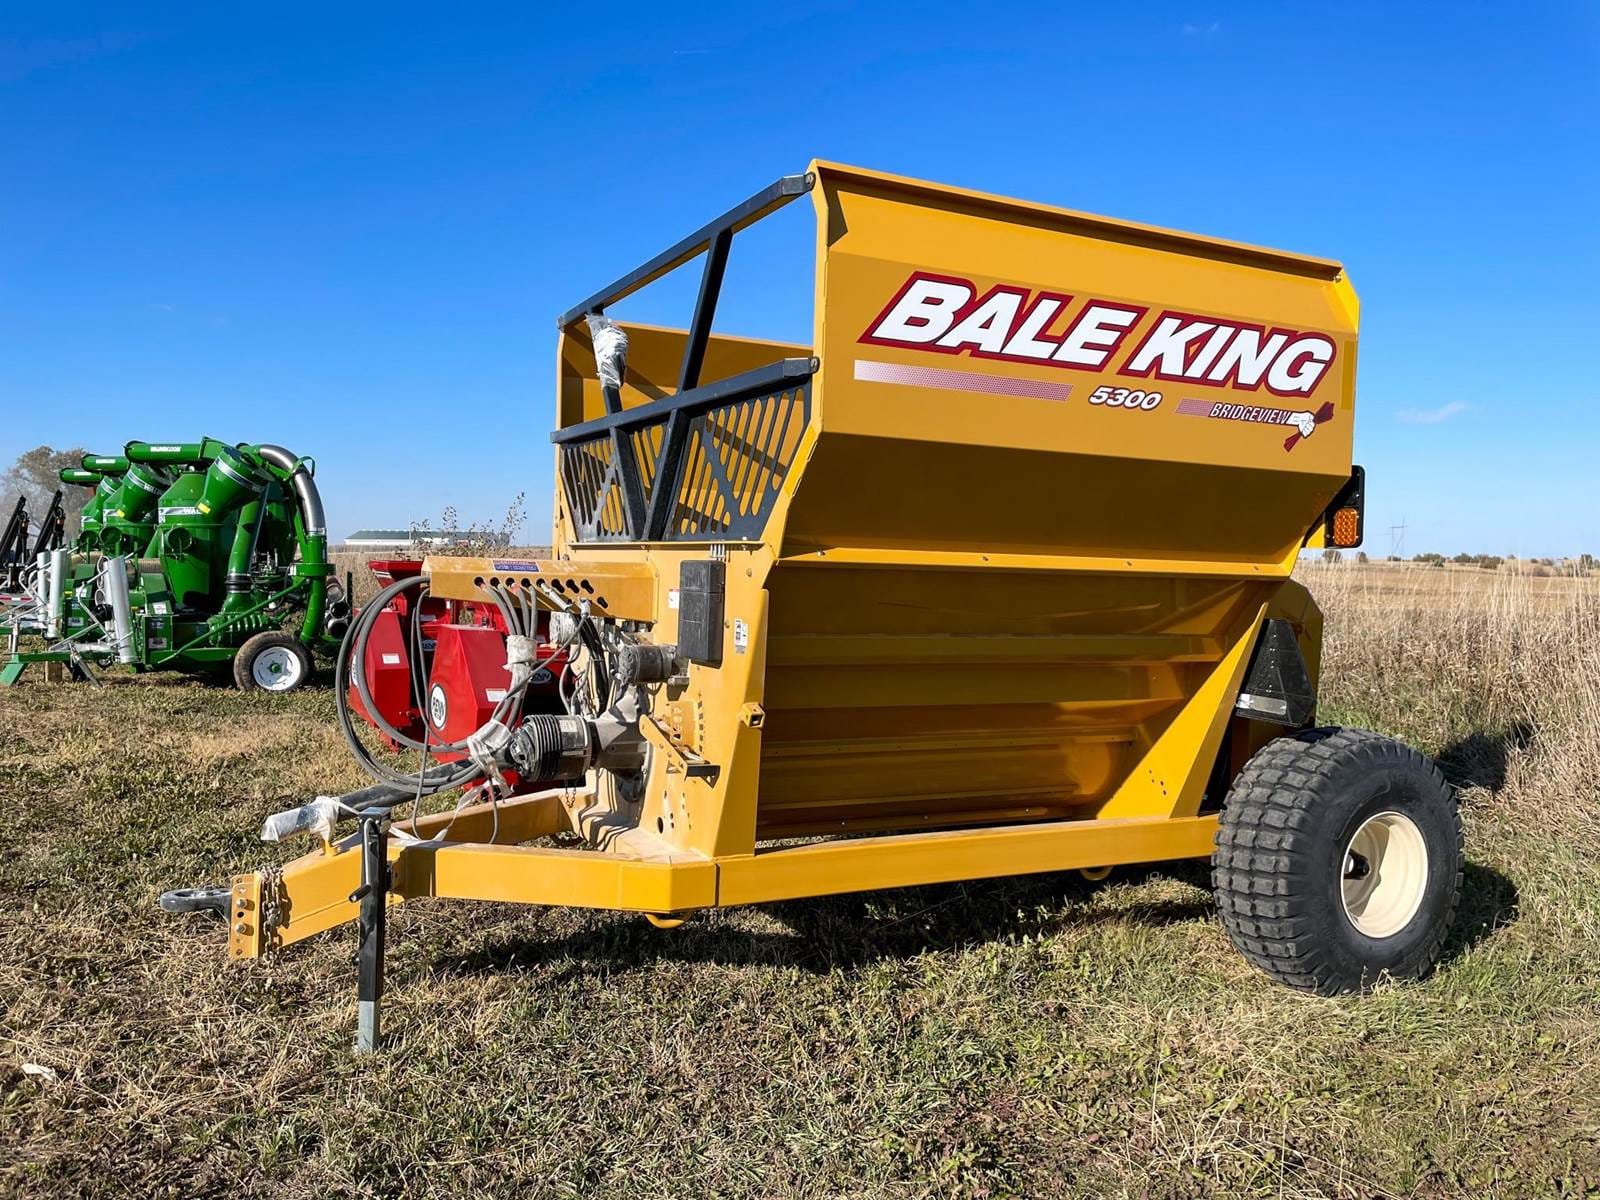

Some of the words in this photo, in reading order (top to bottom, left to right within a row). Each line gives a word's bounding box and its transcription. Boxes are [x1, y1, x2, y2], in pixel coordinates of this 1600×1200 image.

[870, 278, 1139, 366] BALE
[1127, 316, 1334, 392] KING
[1088, 385, 1162, 411] 5300
[1210, 402, 1289, 424] BRIDGEVIEW
